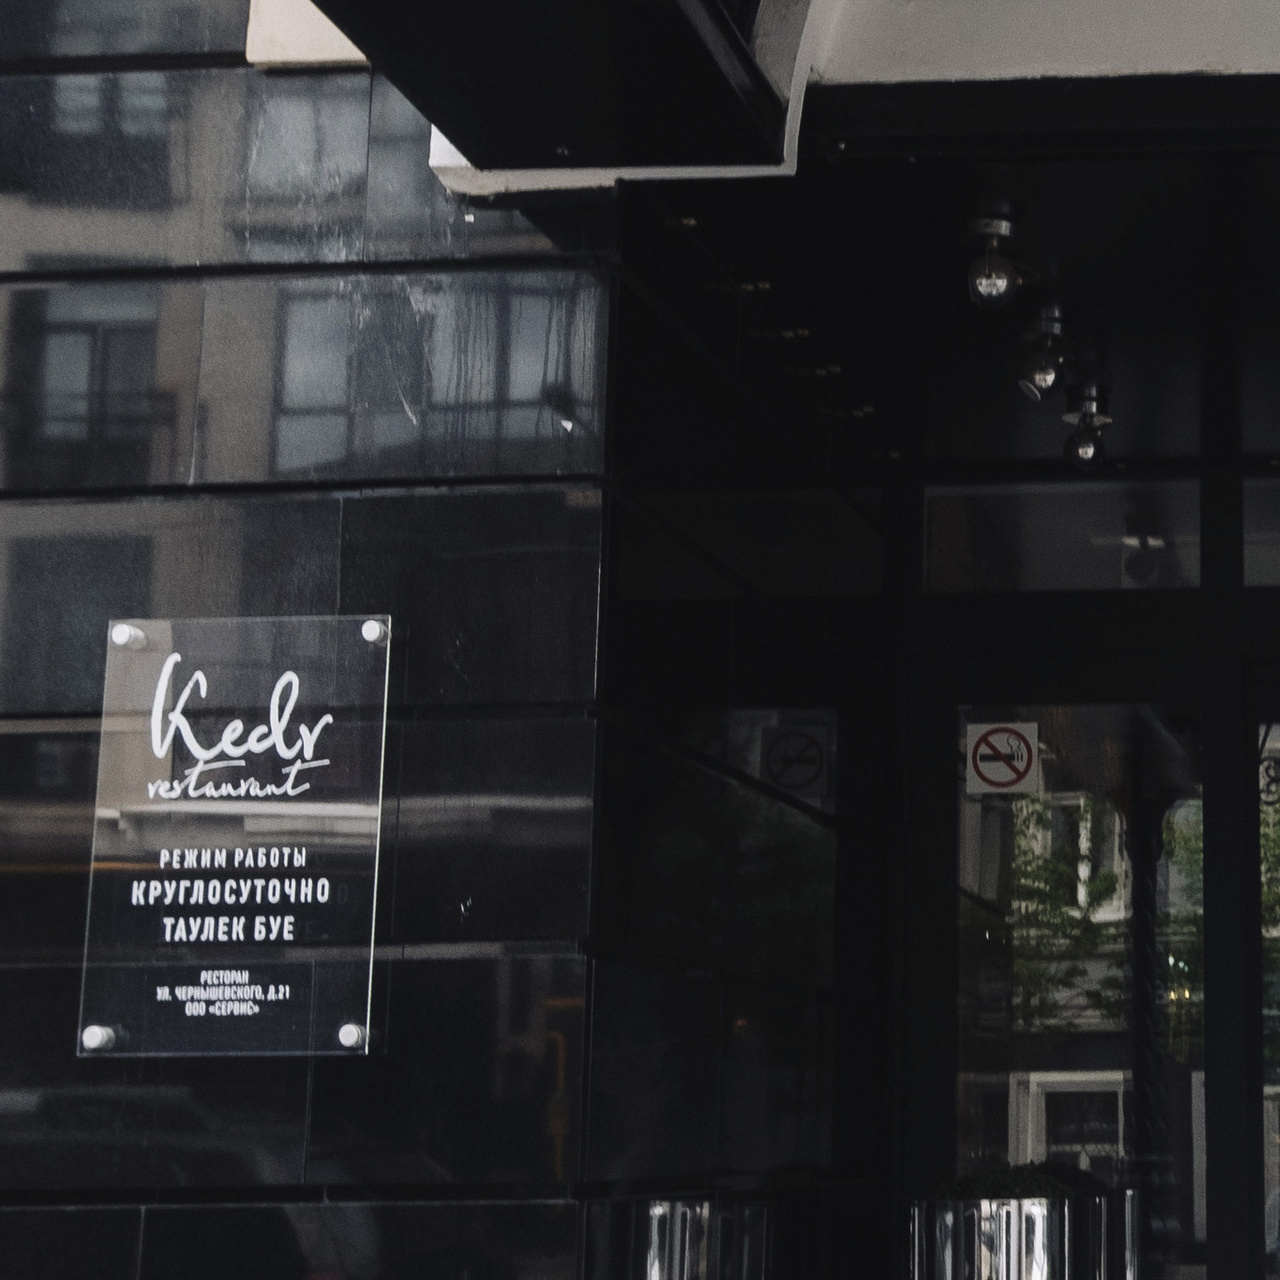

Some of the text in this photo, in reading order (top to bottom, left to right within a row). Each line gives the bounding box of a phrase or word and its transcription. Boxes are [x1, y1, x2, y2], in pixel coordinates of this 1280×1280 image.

[151, 652, 334, 761] Kedr
[147, 758, 331, 799] restaurant
[159, 847, 307, 869] РЕЖИМ РАБОТЫ
[131, 878, 330, 906] КРУГЛОСУТОЧНО
[163, 915, 295, 942] ТАУЛЕК БУЕ
[200, 970, 249, 985] РЕСТОРАН
[156, 986, 172, 1001] УЛ.
[185, 1001, 206, 1016] ООО
